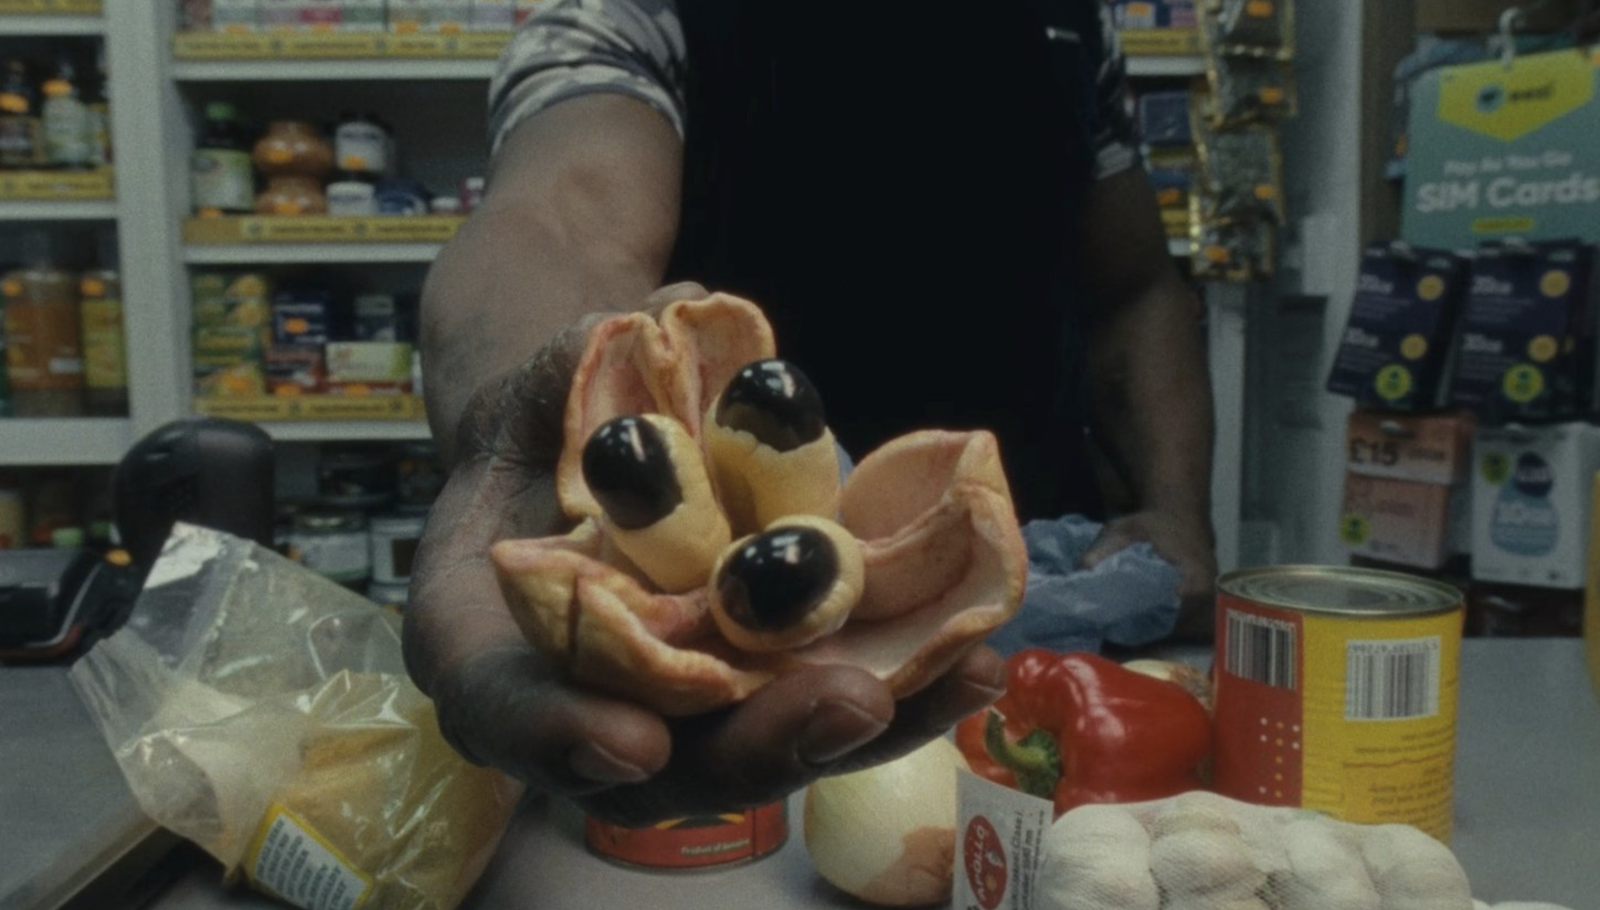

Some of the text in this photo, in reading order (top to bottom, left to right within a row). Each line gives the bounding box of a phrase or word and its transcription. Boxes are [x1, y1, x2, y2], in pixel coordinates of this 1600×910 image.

[1416, 173, 1600, 214] SIM Cards
[1349, 437, 1400, 467] £15
[971, 824, 987, 900] APOLLO
